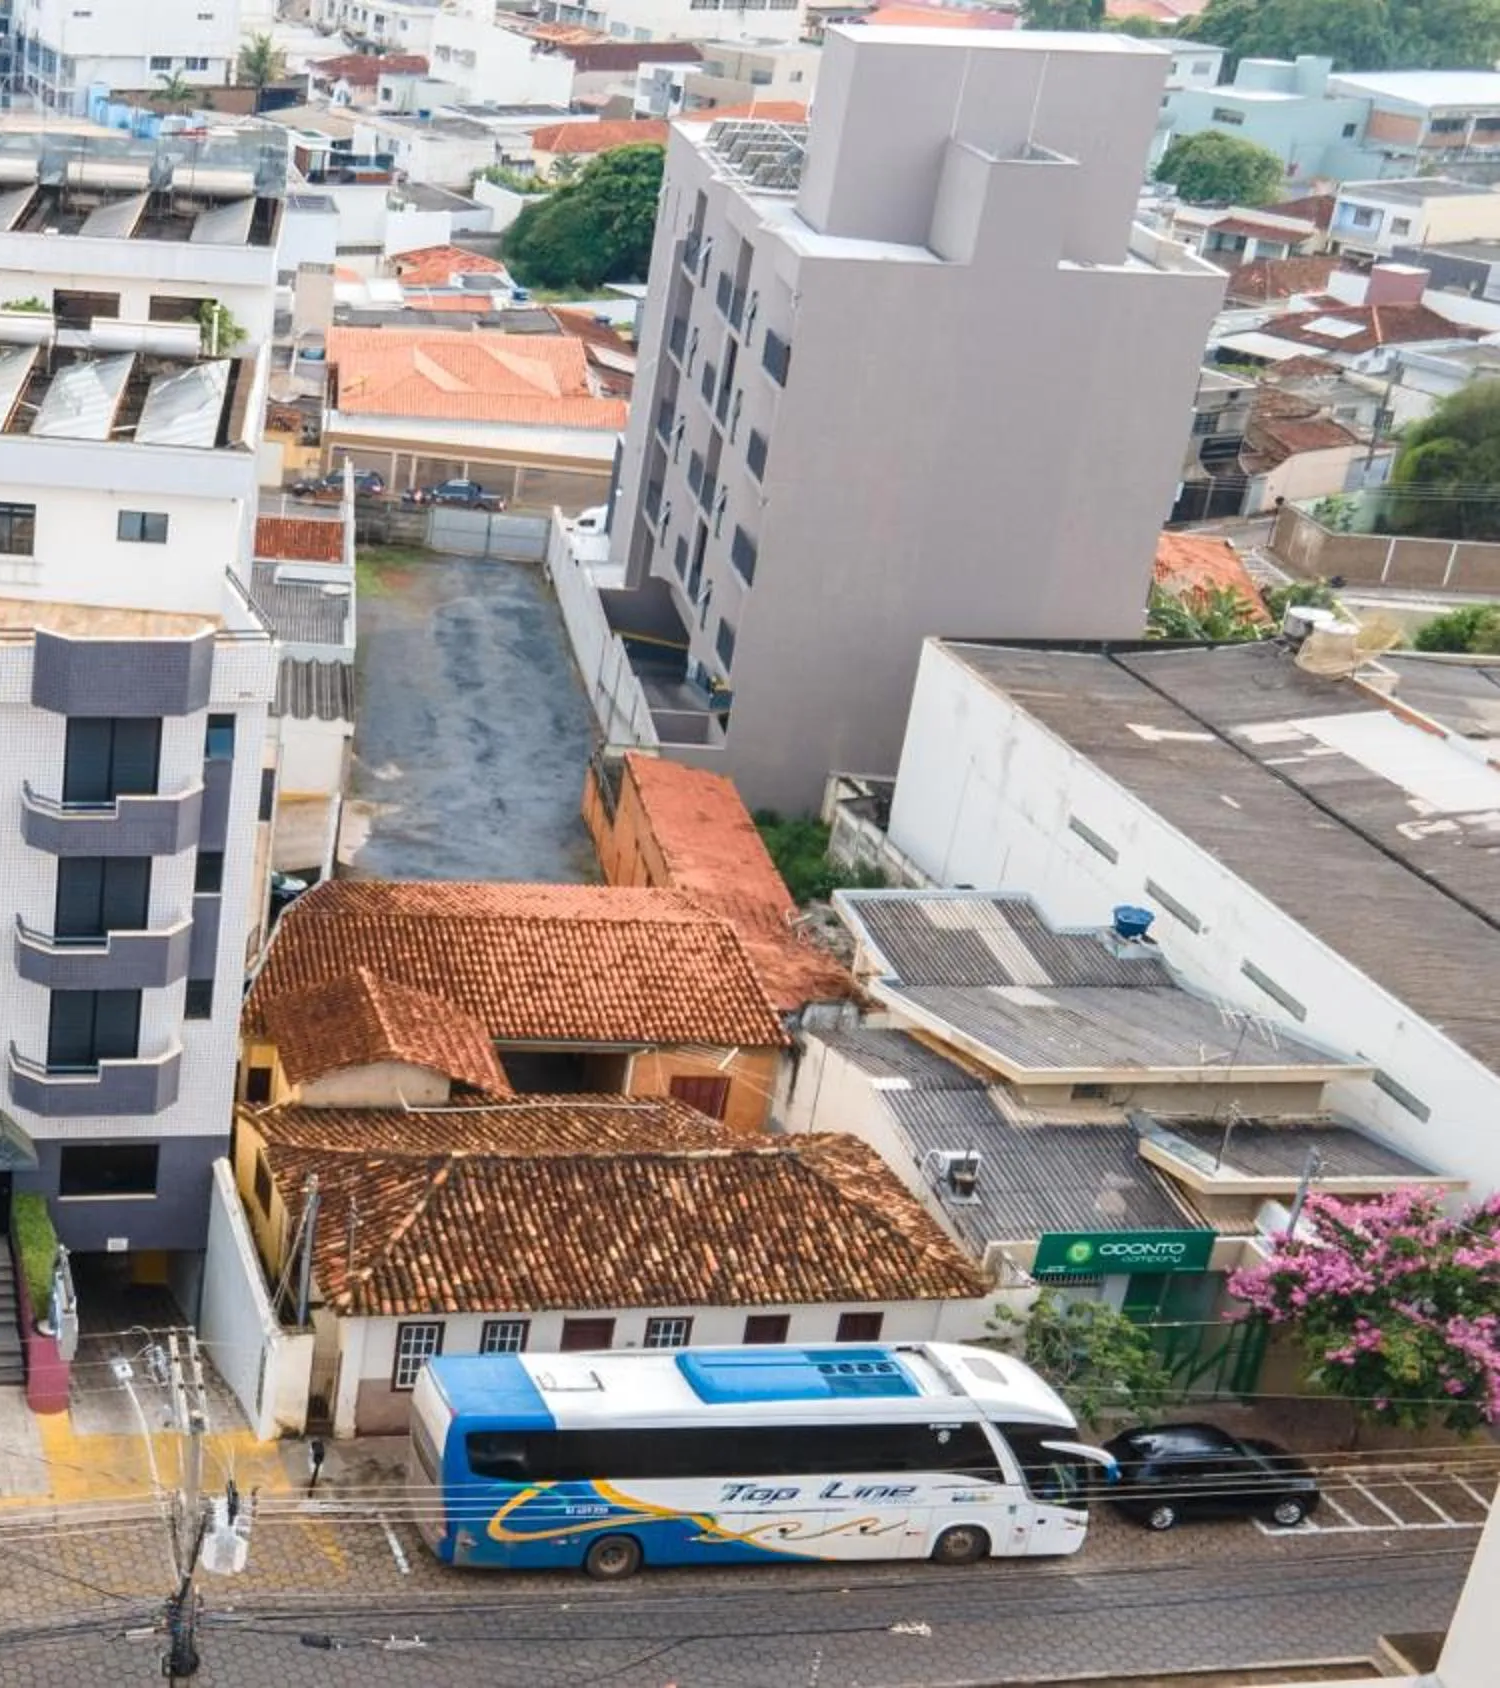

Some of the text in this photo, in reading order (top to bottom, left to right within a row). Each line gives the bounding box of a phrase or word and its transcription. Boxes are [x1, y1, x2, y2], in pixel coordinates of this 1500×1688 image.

[1098, 1243, 1186, 1256] ODONTO
[1120, 1254, 1182, 1264] company
[720, 1480, 918, 1506] Top Line
